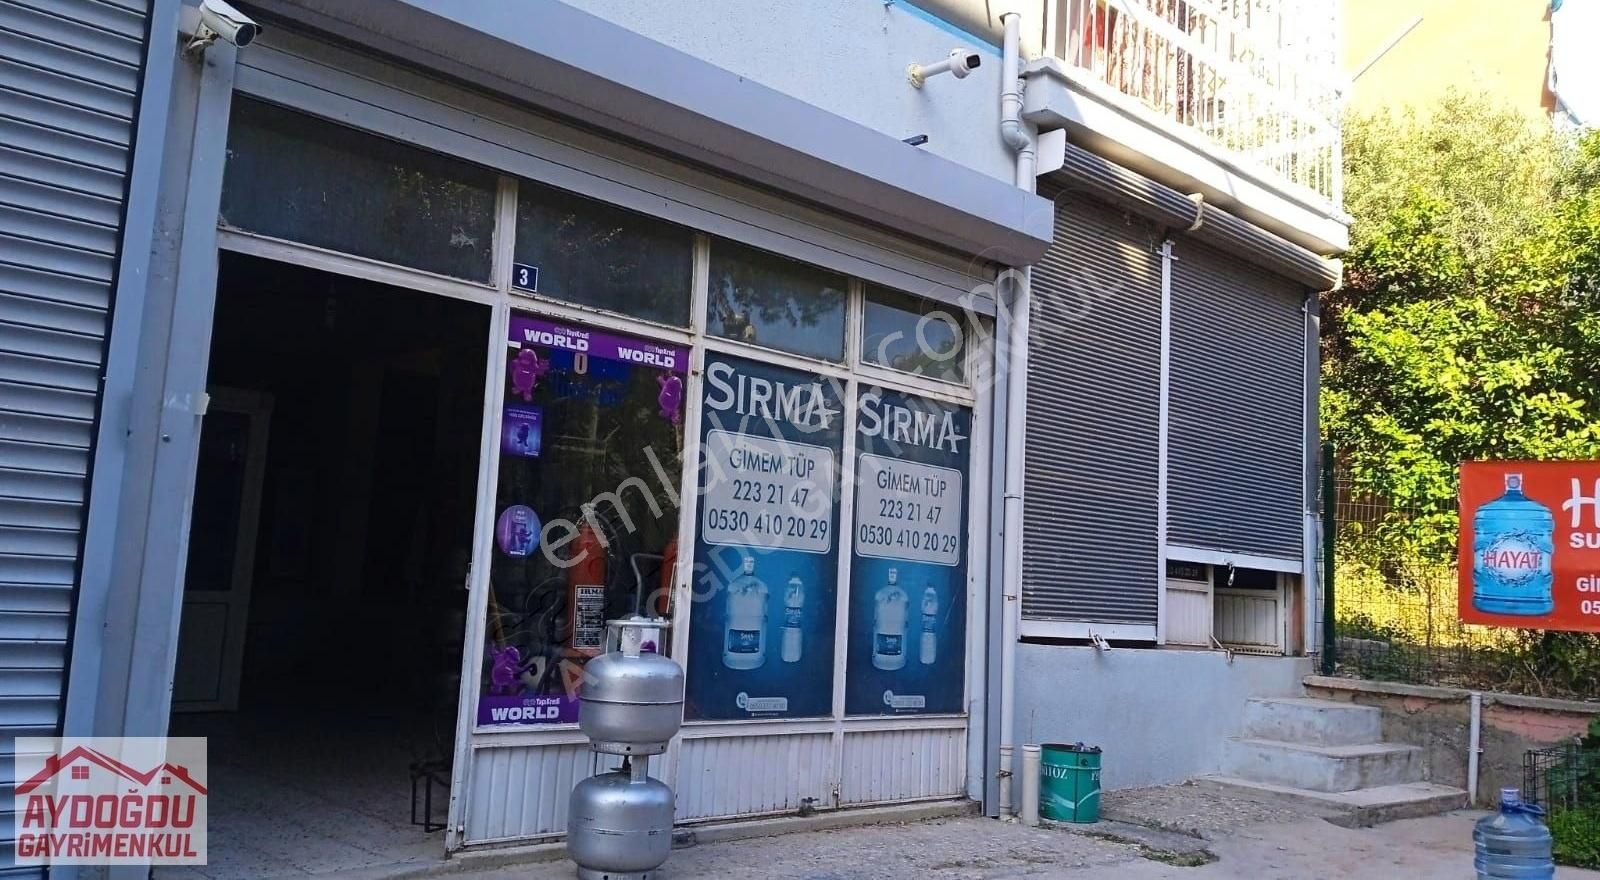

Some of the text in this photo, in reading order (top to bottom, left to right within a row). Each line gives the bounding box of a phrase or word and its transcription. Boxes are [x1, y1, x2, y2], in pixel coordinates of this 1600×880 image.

[519, 269, 528, 286] 3
[524, 328, 589, 351] WORLD
[618, 346, 675, 368] WORLD
[705, 361, 840, 429] SIRMA
[857, 392, 967, 453] SIRMA
[729, 444, 815, 478] GİMEM TÜP
[733, 479, 808, 508] 223 21 47
[877, 467, 947, 498] GİMEM TÜP
[708, 508, 828, 541] 0530 410 20 29
[880, 498, 941, 525] 223 21 47
[860, 524, 957, 554] 0530 410 20 29
[1569, 532, 1600, 549] SU
[1483, 551, 1541, 569] HAYAT
[1576, 574, 1600, 593] Gİ
[491, 706, 559, 721] WORLD
